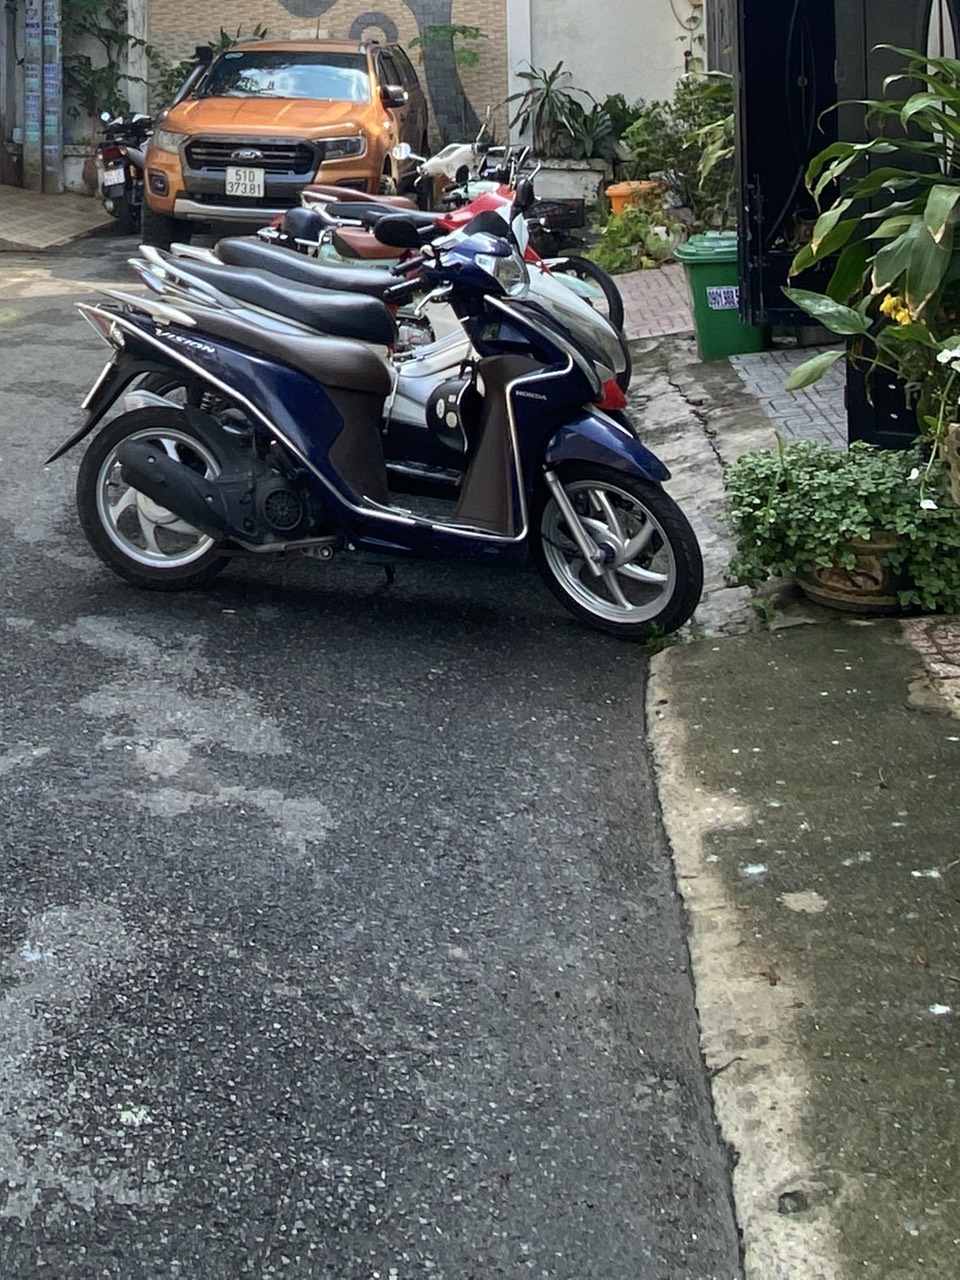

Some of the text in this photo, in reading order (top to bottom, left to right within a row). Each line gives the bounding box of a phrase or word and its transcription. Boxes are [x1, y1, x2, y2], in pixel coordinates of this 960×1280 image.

[235, 169, 256, 183] 51D
[155, 327, 216, 353] VISION
[515, 390, 547, 401] HONDA
